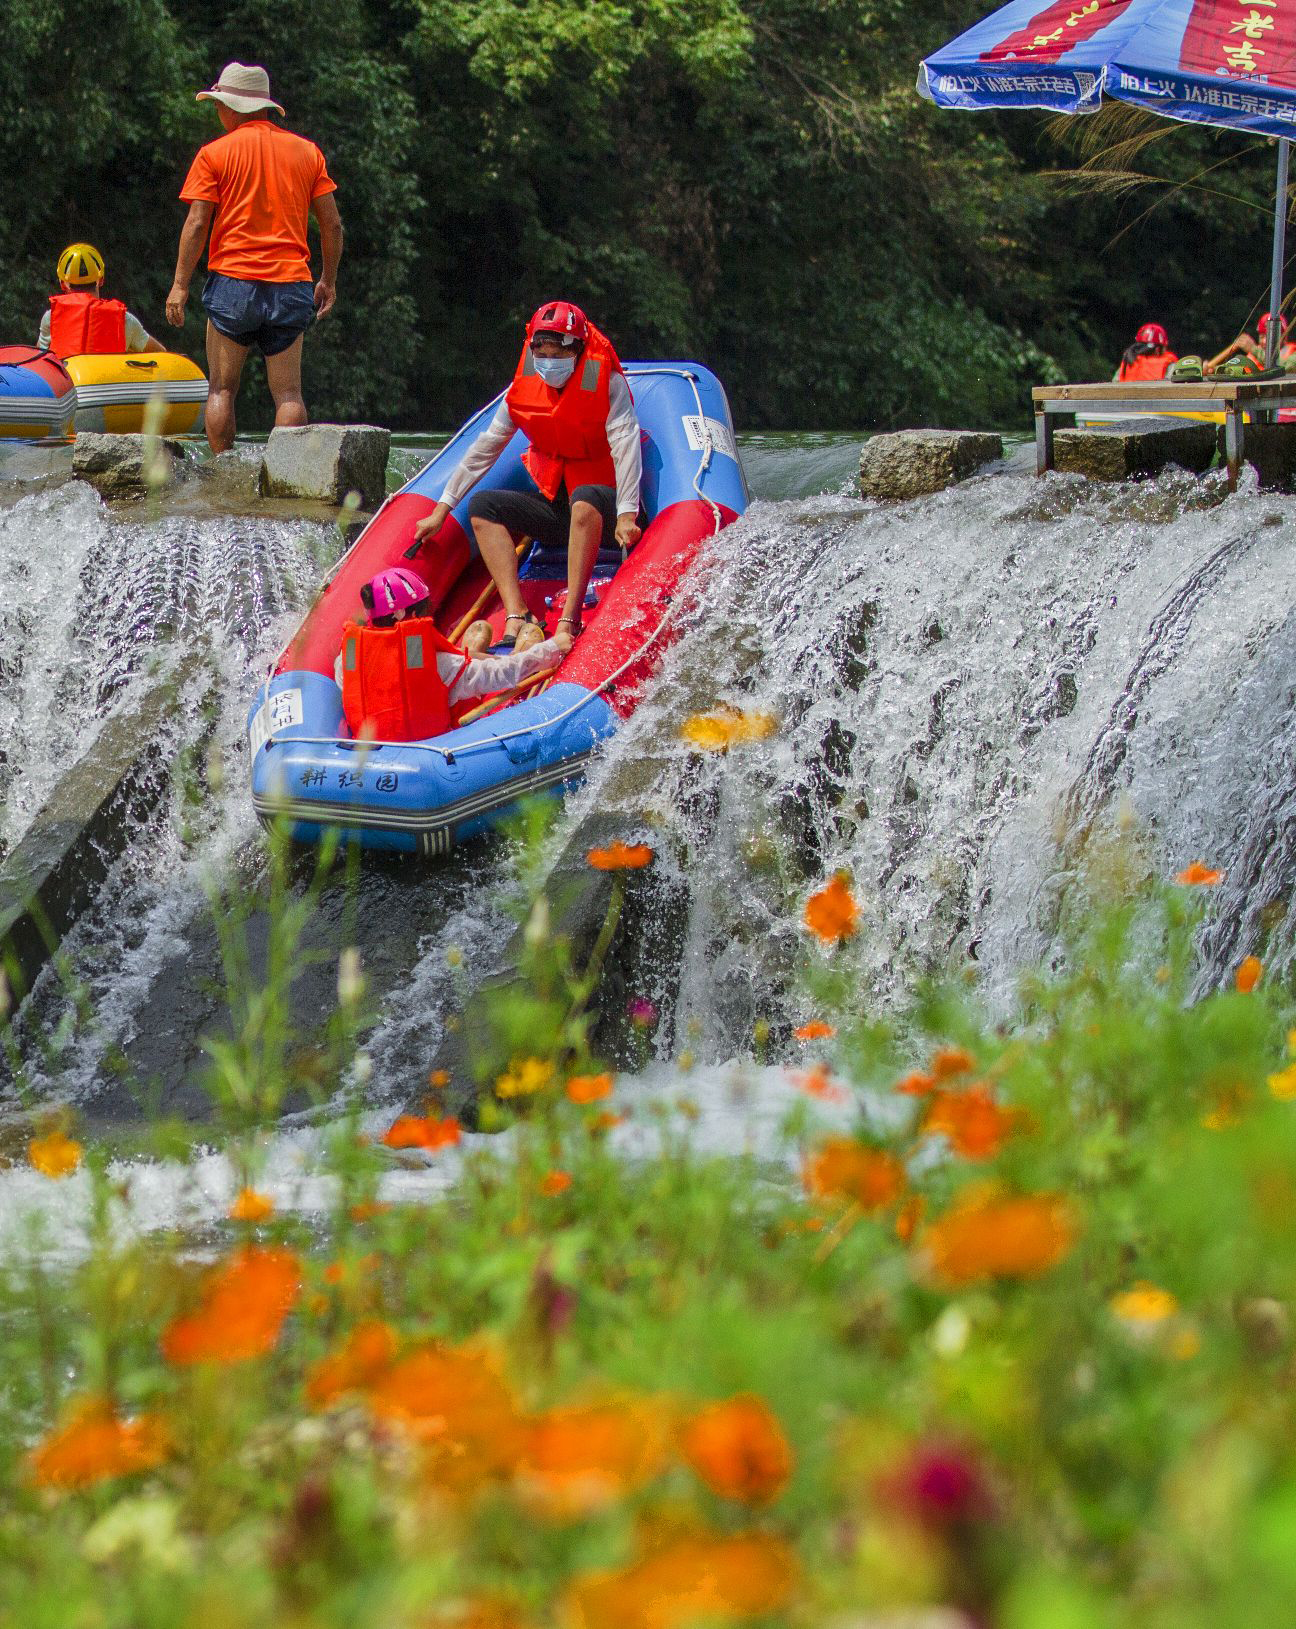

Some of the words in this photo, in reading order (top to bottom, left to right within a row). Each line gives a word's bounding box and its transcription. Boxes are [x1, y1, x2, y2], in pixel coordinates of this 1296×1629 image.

[938, 75, 985, 93] 怕上火
[982, 76, 1077, 96] 认准正宗王老吉
[1120, 72, 1176, 99] 怕上火
[1184, 83, 1296, 123] 认准正宗王老
